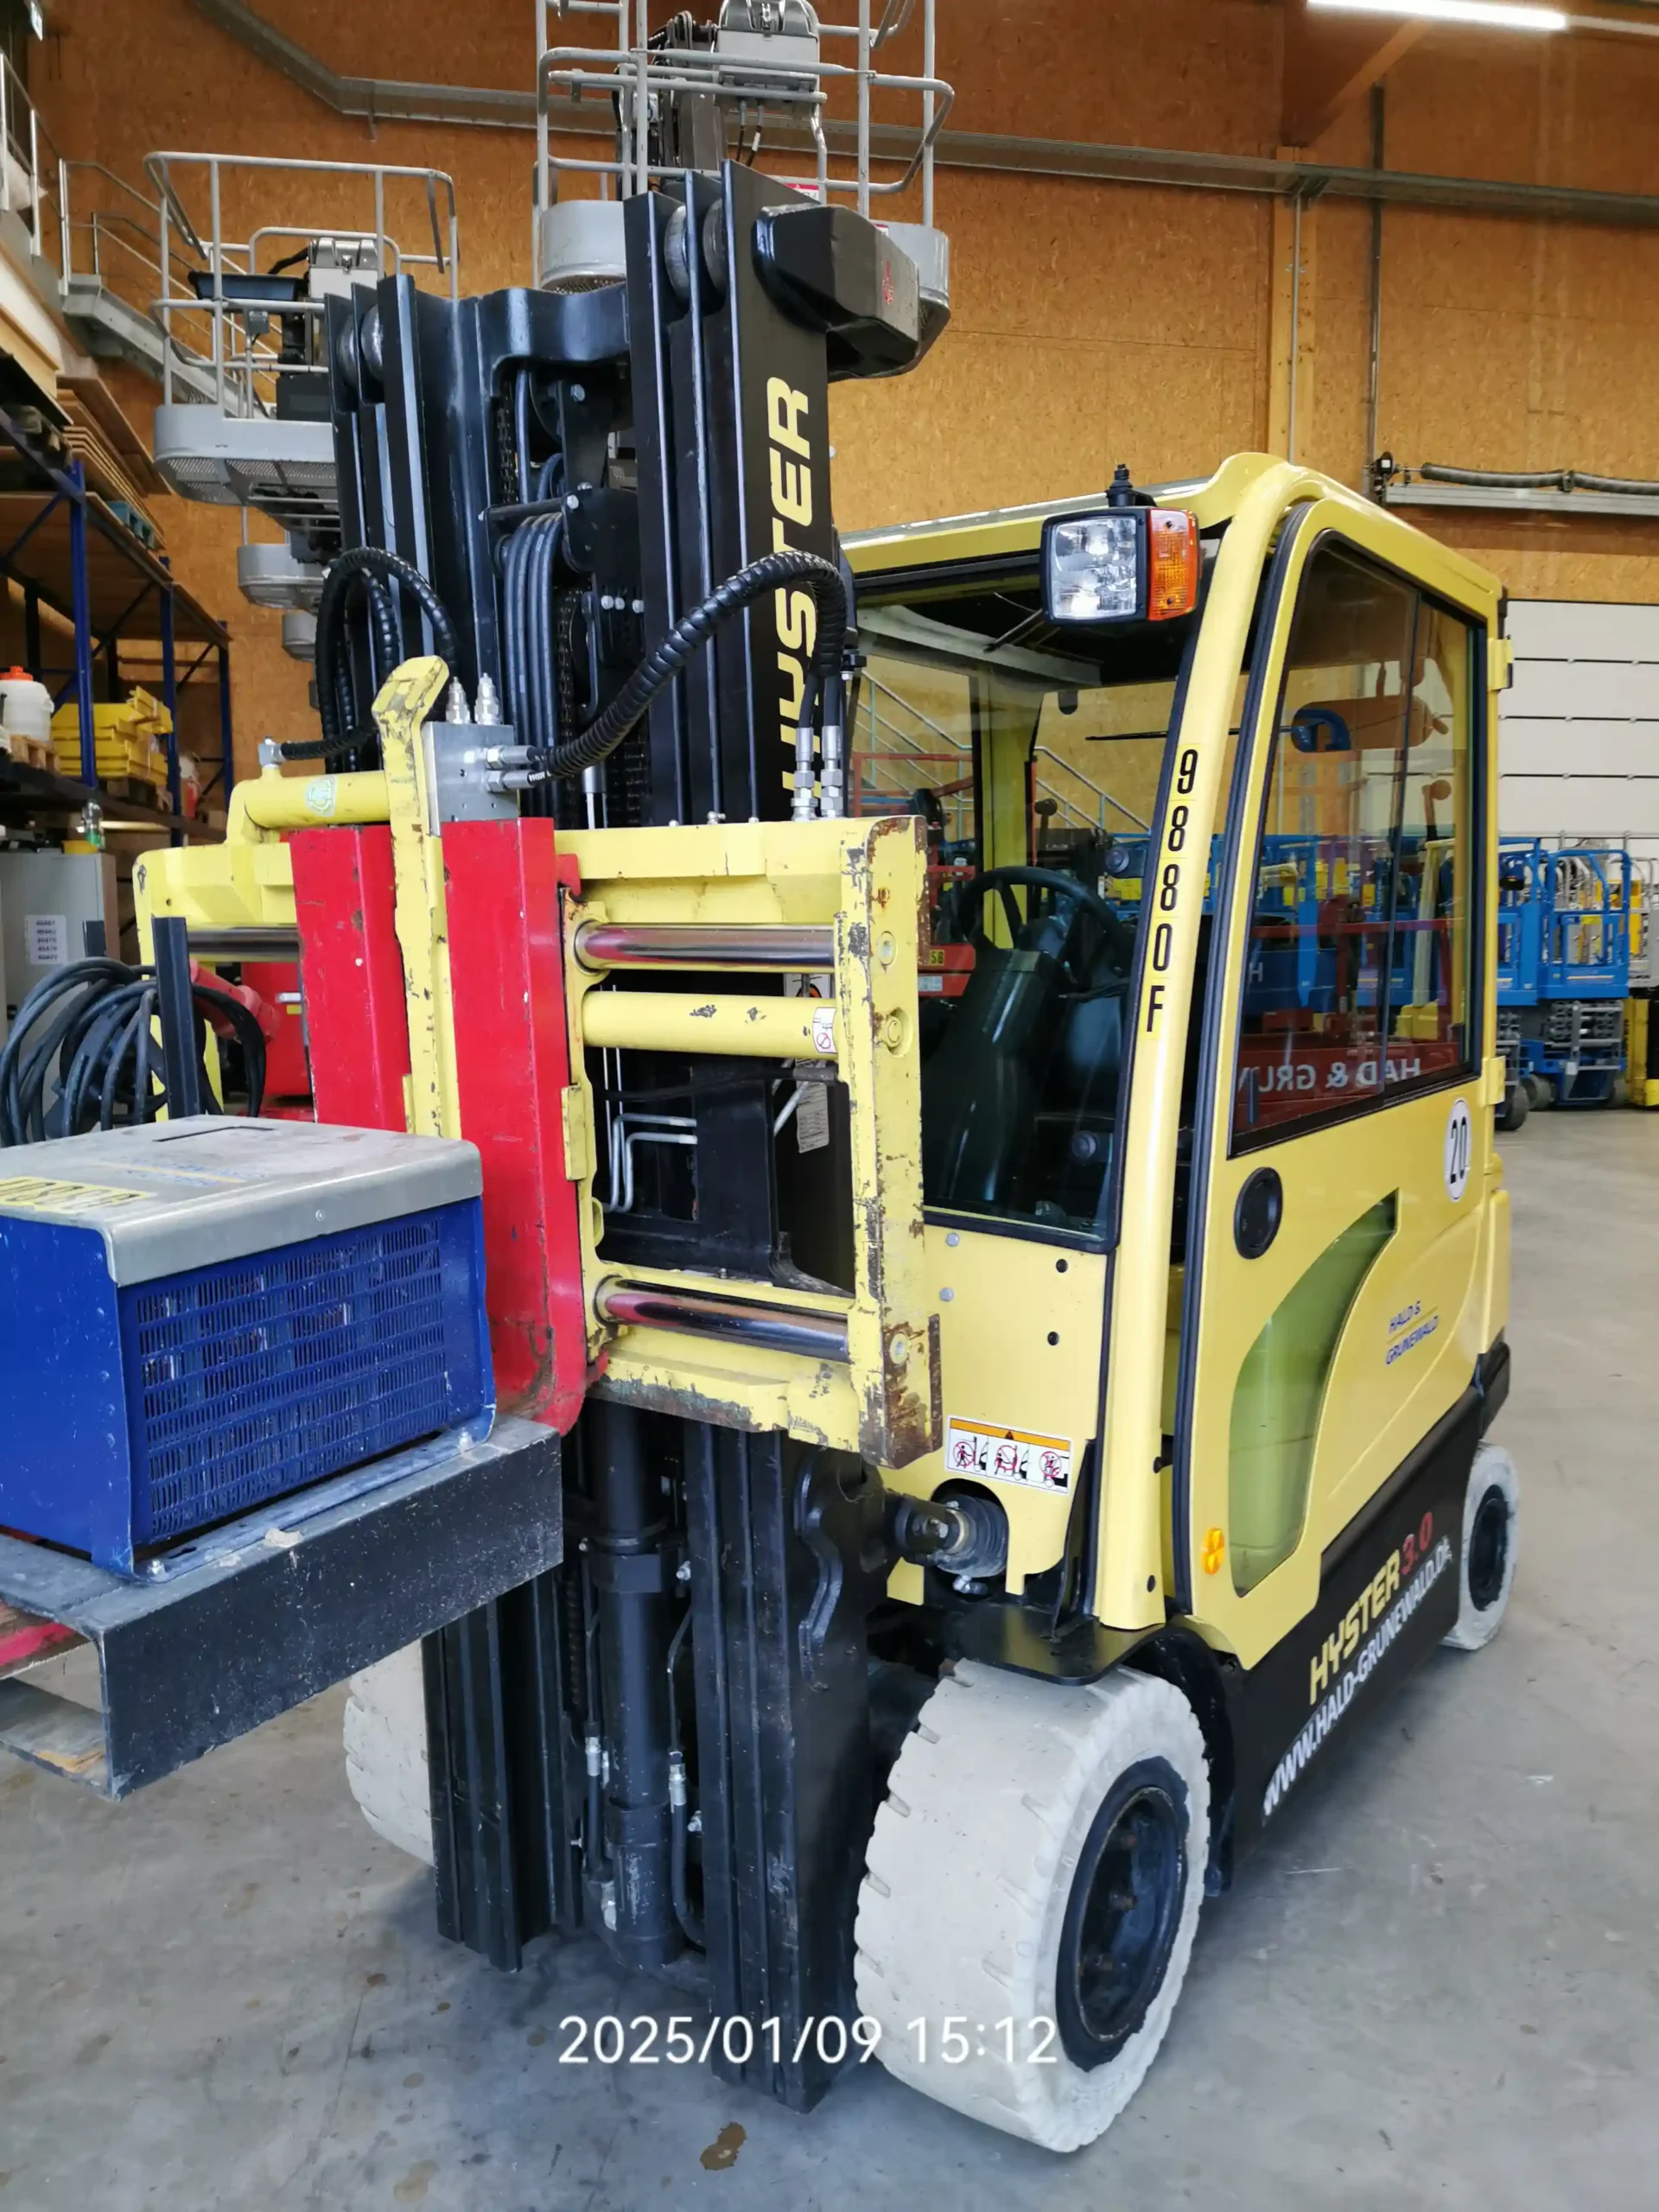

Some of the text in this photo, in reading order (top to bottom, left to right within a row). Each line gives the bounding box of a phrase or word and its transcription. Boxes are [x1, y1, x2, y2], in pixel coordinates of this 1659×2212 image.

[1450, 1116, 1467, 1184] 20
[1309, 1511, 1433, 1705] HYSTER 3.0
